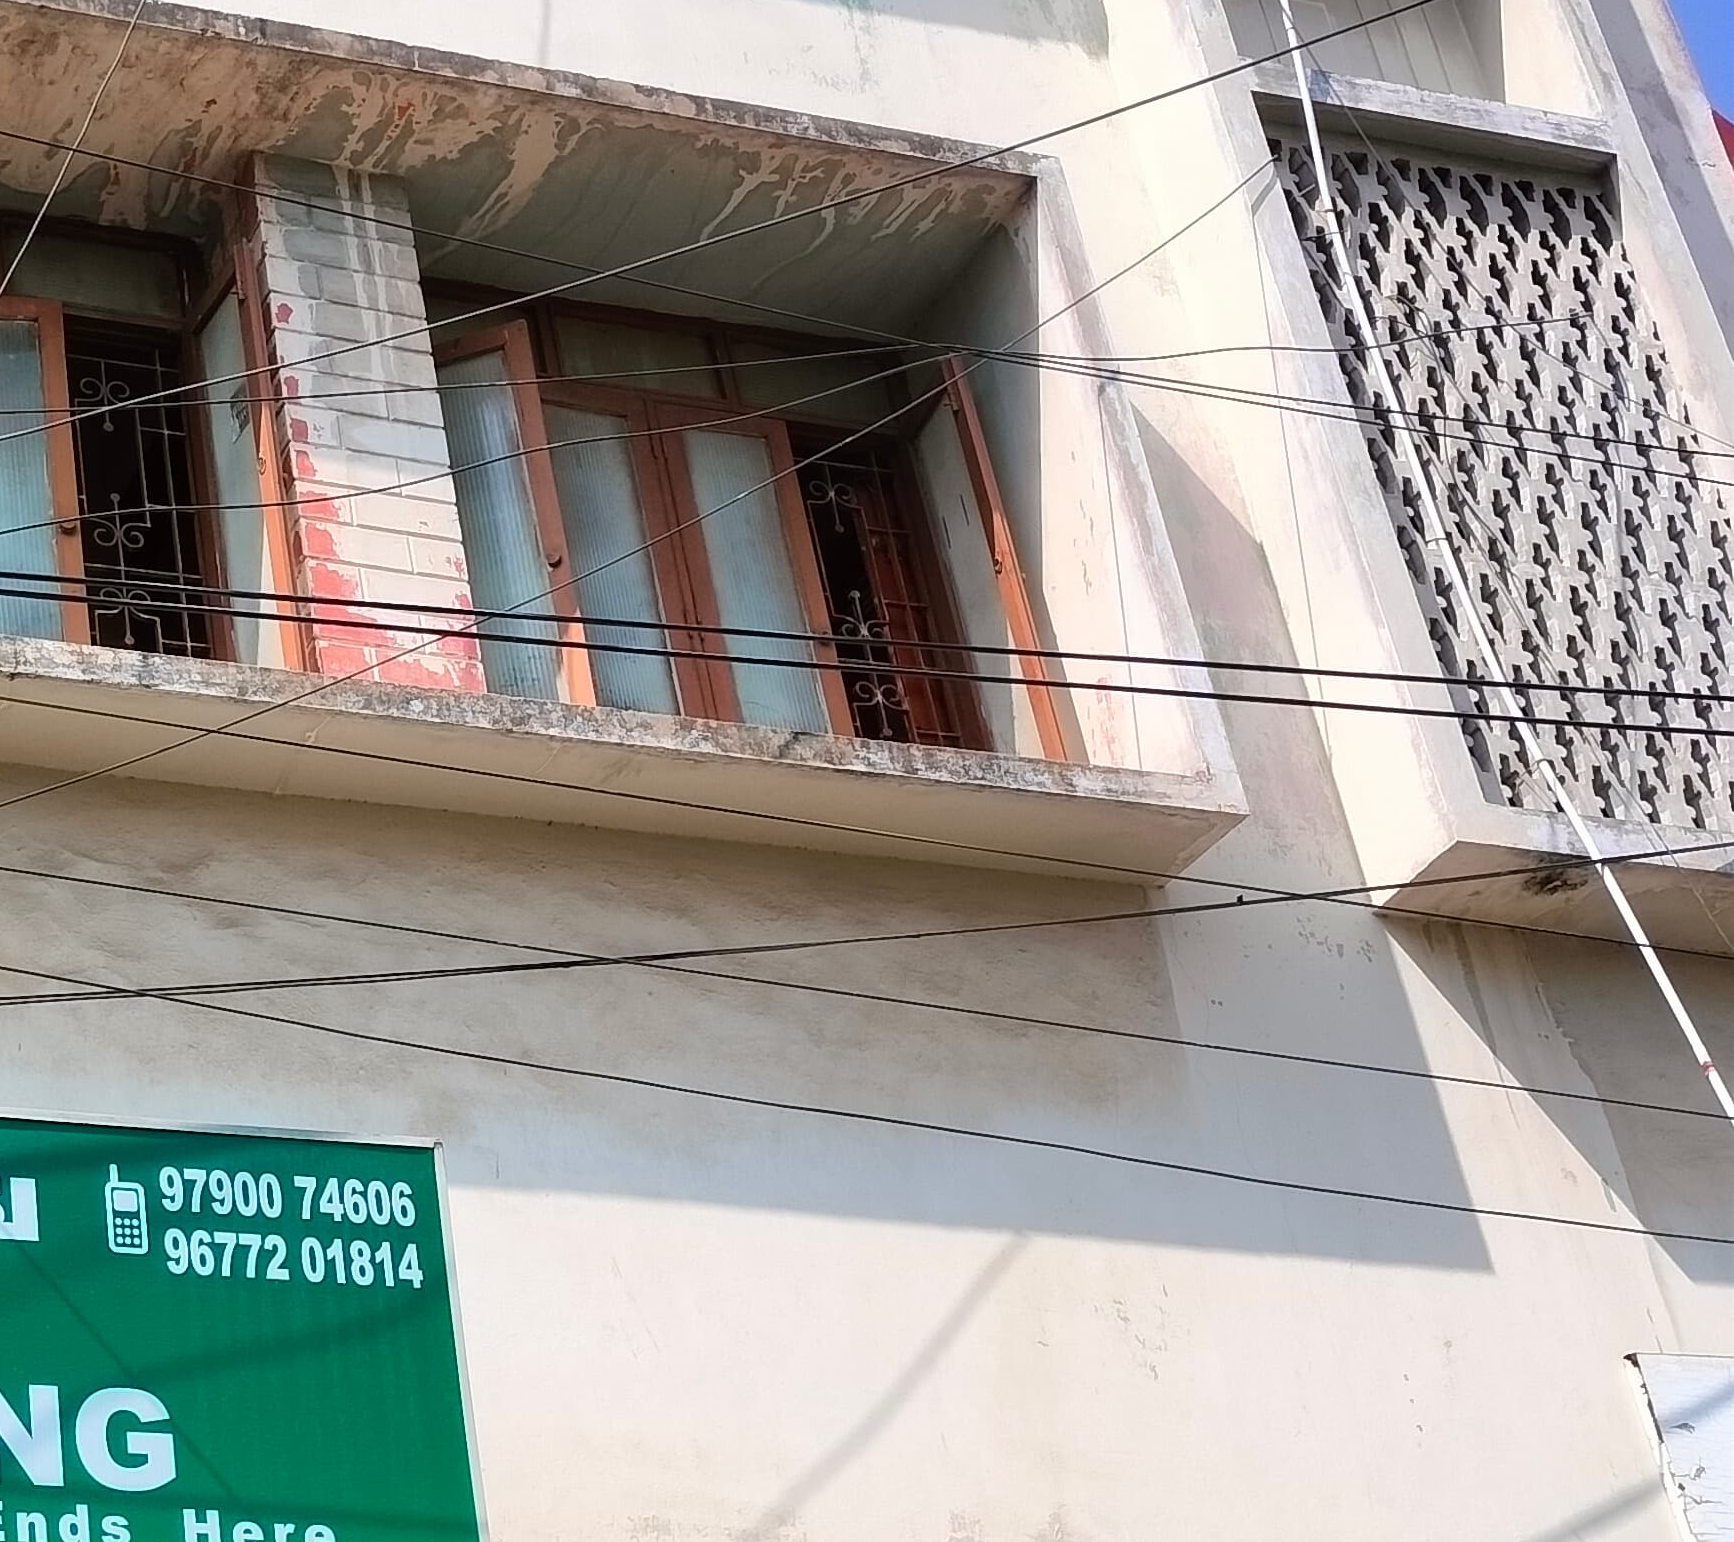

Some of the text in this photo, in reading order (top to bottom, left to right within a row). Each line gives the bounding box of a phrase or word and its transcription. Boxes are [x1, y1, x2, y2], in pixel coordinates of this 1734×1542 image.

[159, 1166, 416, 1227] 97900 74606
[164, 1228, 424, 1289] 96772 01814
